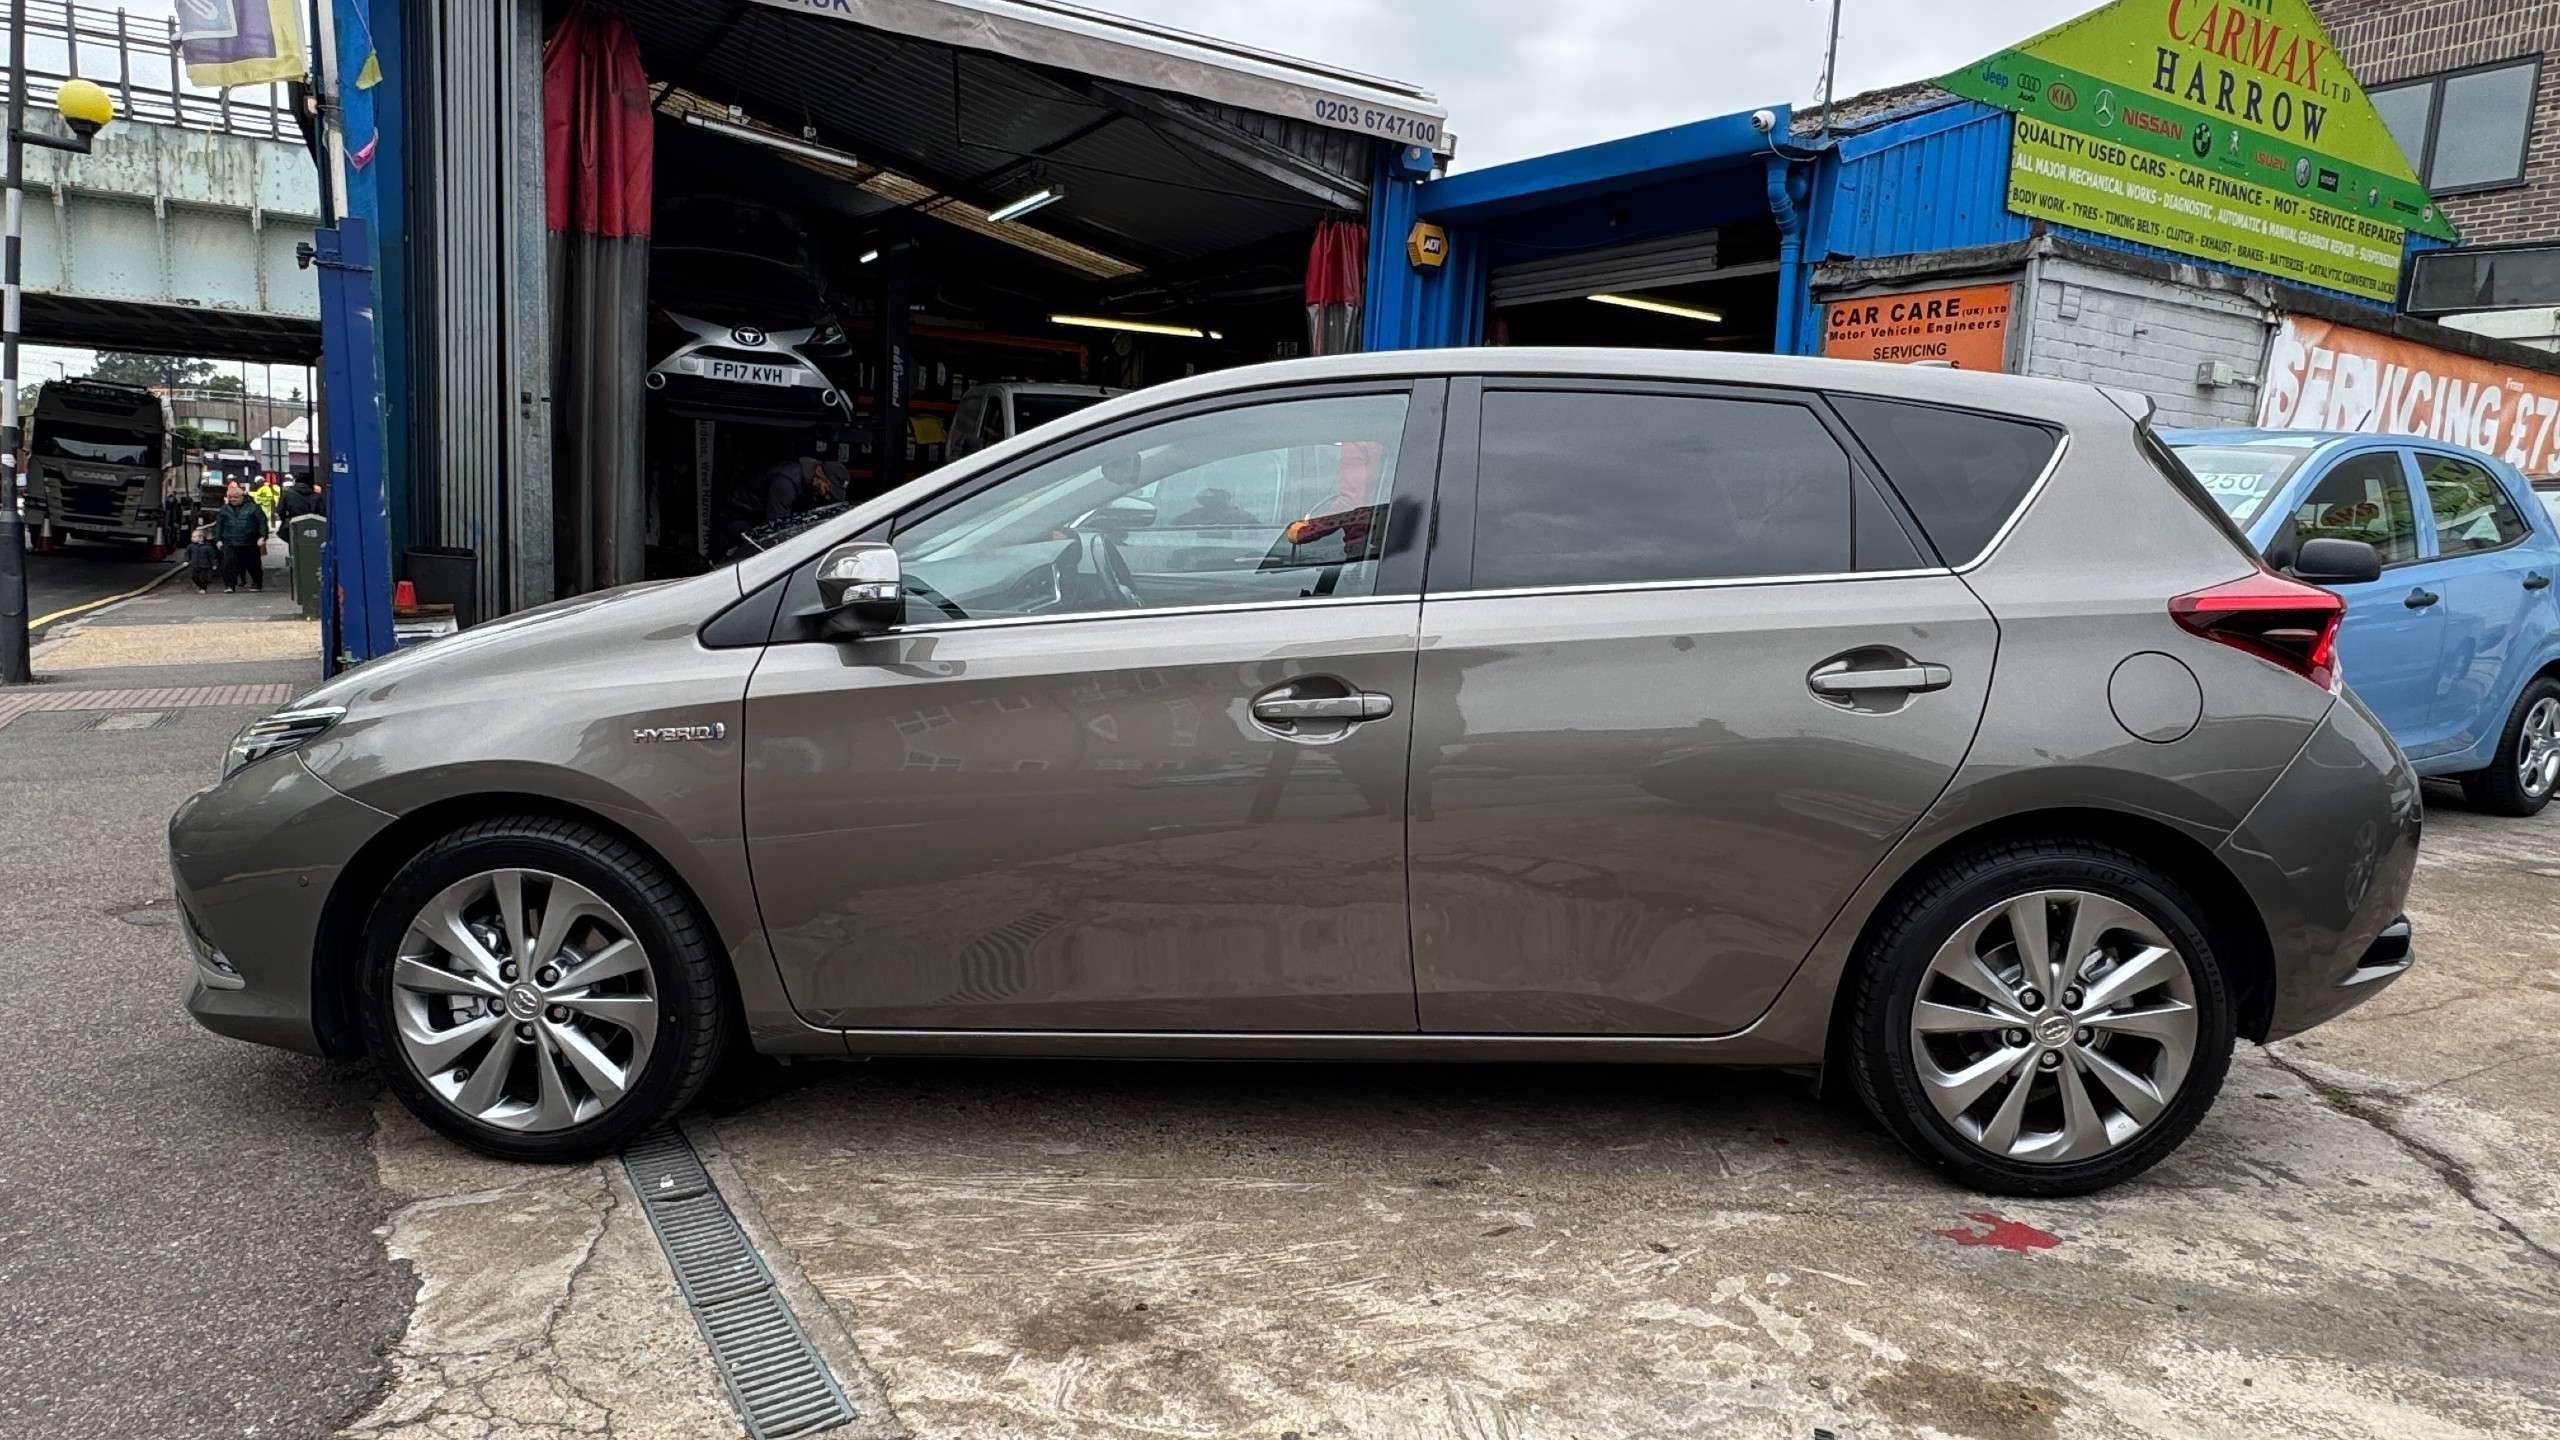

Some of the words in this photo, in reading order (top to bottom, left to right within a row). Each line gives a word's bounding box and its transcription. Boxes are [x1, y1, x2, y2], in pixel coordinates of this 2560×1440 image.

[2167, 0, 2327, 92] CARMAX
[2320, 79, 2351, 104] LTD
[1982, 63, 2009, 90] Jeep
[2052, 87, 2073, 106] KIA
[2152, 46, 2328, 144] HARROW
[1315, 99, 1359, 125] 0203
[1364, 110, 1436, 142] 6747100
[2122, 107, 2184, 141] NISSAN
[2015, 153, 2033, 172] ALL
[2035, 158, 2067, 182] MAJOR
[2067, 167, 2124, 197] MECHANICAL
[2126, 182, 2157, 205] WORKS
[2162, 192, 2213, 220] DIAGNOSTIC
[2217, 208, 2261, 233] AUTOMATIC
[2017, 121, 2085, 154] QUALITY
[2088, 141, 2126, 166] USED
[2130, 154, 2166, 178] CARS
[2179, 167, 2205, 191] CAR
[2208, 176, 2263, 206] FINANCE
[2273, 196, 2299, 216] MOT
[2308, 207, 2357, 233] SERVICE
[2357, 220, 2402, 246] REPAIRS
[1425, 238, 1440, 252] ADT
[2012, 187, 2038, 206] BODY
[2039, 195, 2065, 213] WORK
[2073, 202, 2098, 221] TYRES
[2105, 211, 2135, 230] TIMING
[2136, 219, 2160, 236] BELTS
[2166, 226, 2194, 245] CLUTCH
[2200, 235, 2233, 254] EXHAUST
[2237, 243, 2264, 262] BRAKES
[2269, 252, 2304, 272] BATTERIES
[2308, 262, 2342, 282] CATALYTIC
[1831, 306, 1879, 328] CAR
[1890, 298, 1961, 323] CARE
[1962, 307, 1984, 318] (UK)
[1987, 305, 2007, 315] LTD
[1829, 329, 1866, 341] Motor
[1870, 322, 1921, 338] Vehicle
[1926, 318, 2001, 335] Engineers
[1872, 342, 1947, 361] SERVICING
[712, 361, 749, 380] FP17
[751, 364, 783, 384] KVH
[2264, 338, 2501, 455] SERVICING
[632, 726, 714, 743] HYBRID
